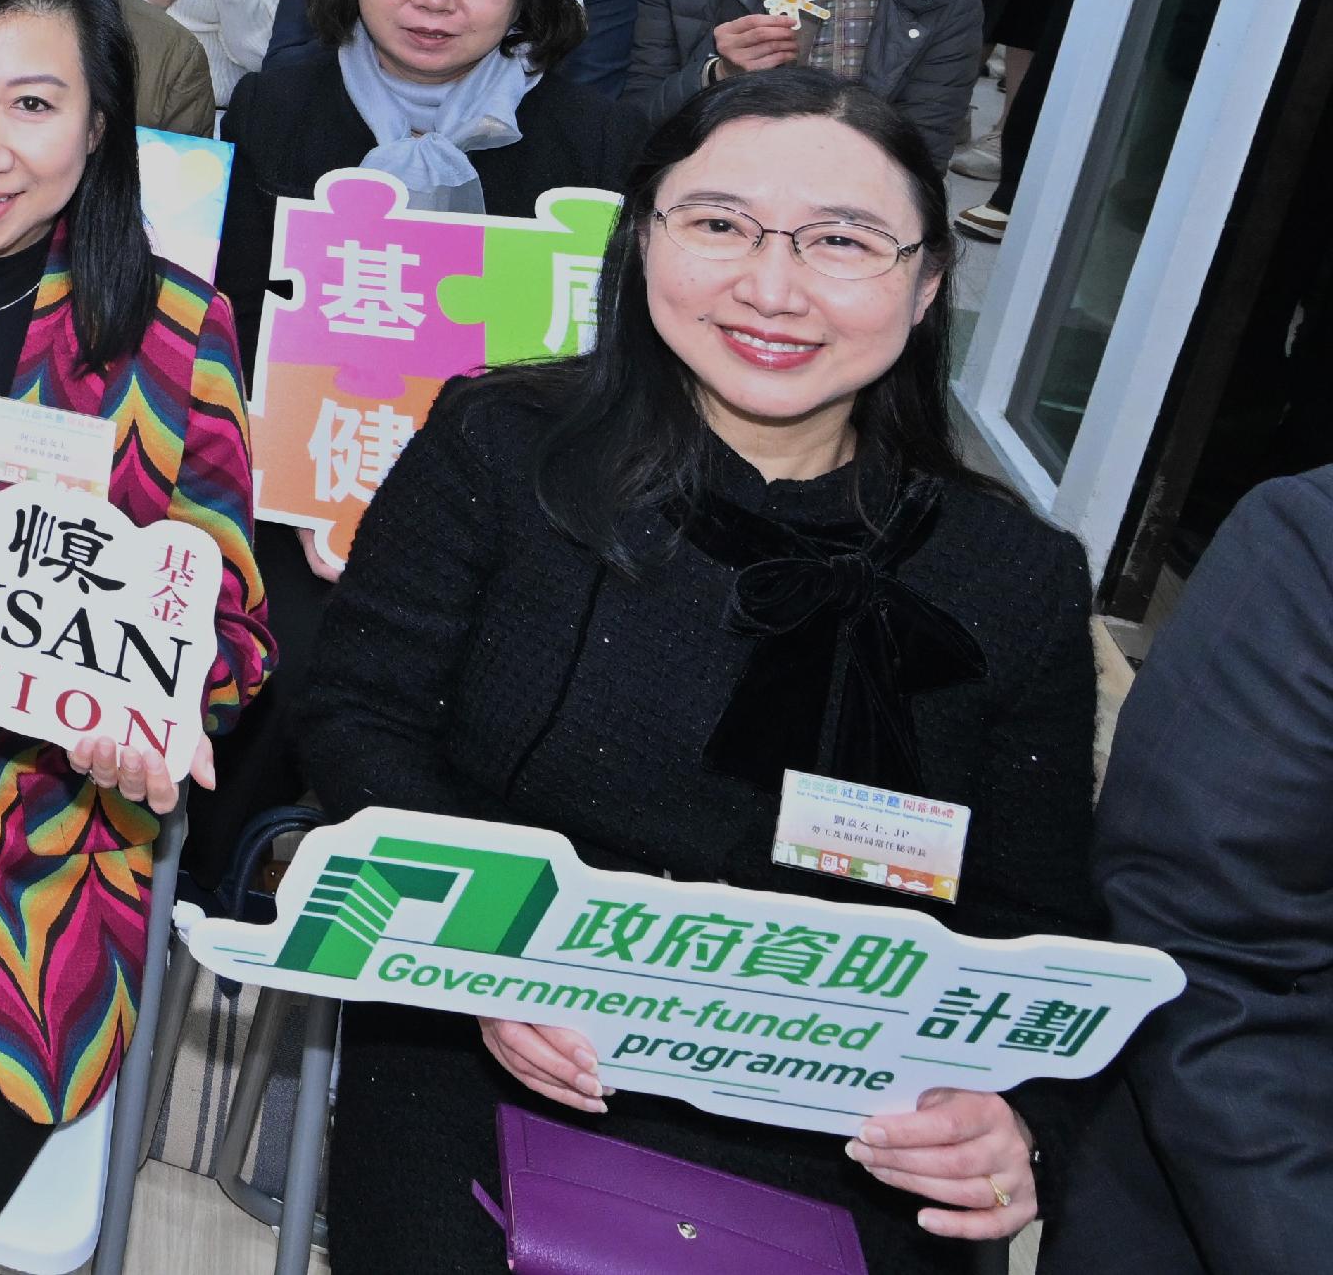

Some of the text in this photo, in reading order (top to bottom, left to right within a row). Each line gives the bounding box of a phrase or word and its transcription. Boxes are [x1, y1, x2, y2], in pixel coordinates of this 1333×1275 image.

[149, 544, 200, 628] 基金
[555, 899, 929, 998] 政府資助
[376, 952, 882, 1052] Government-funded
[916, 985, 1112, 1059] 計劃
[611, 1029, 895, 1094] programme
